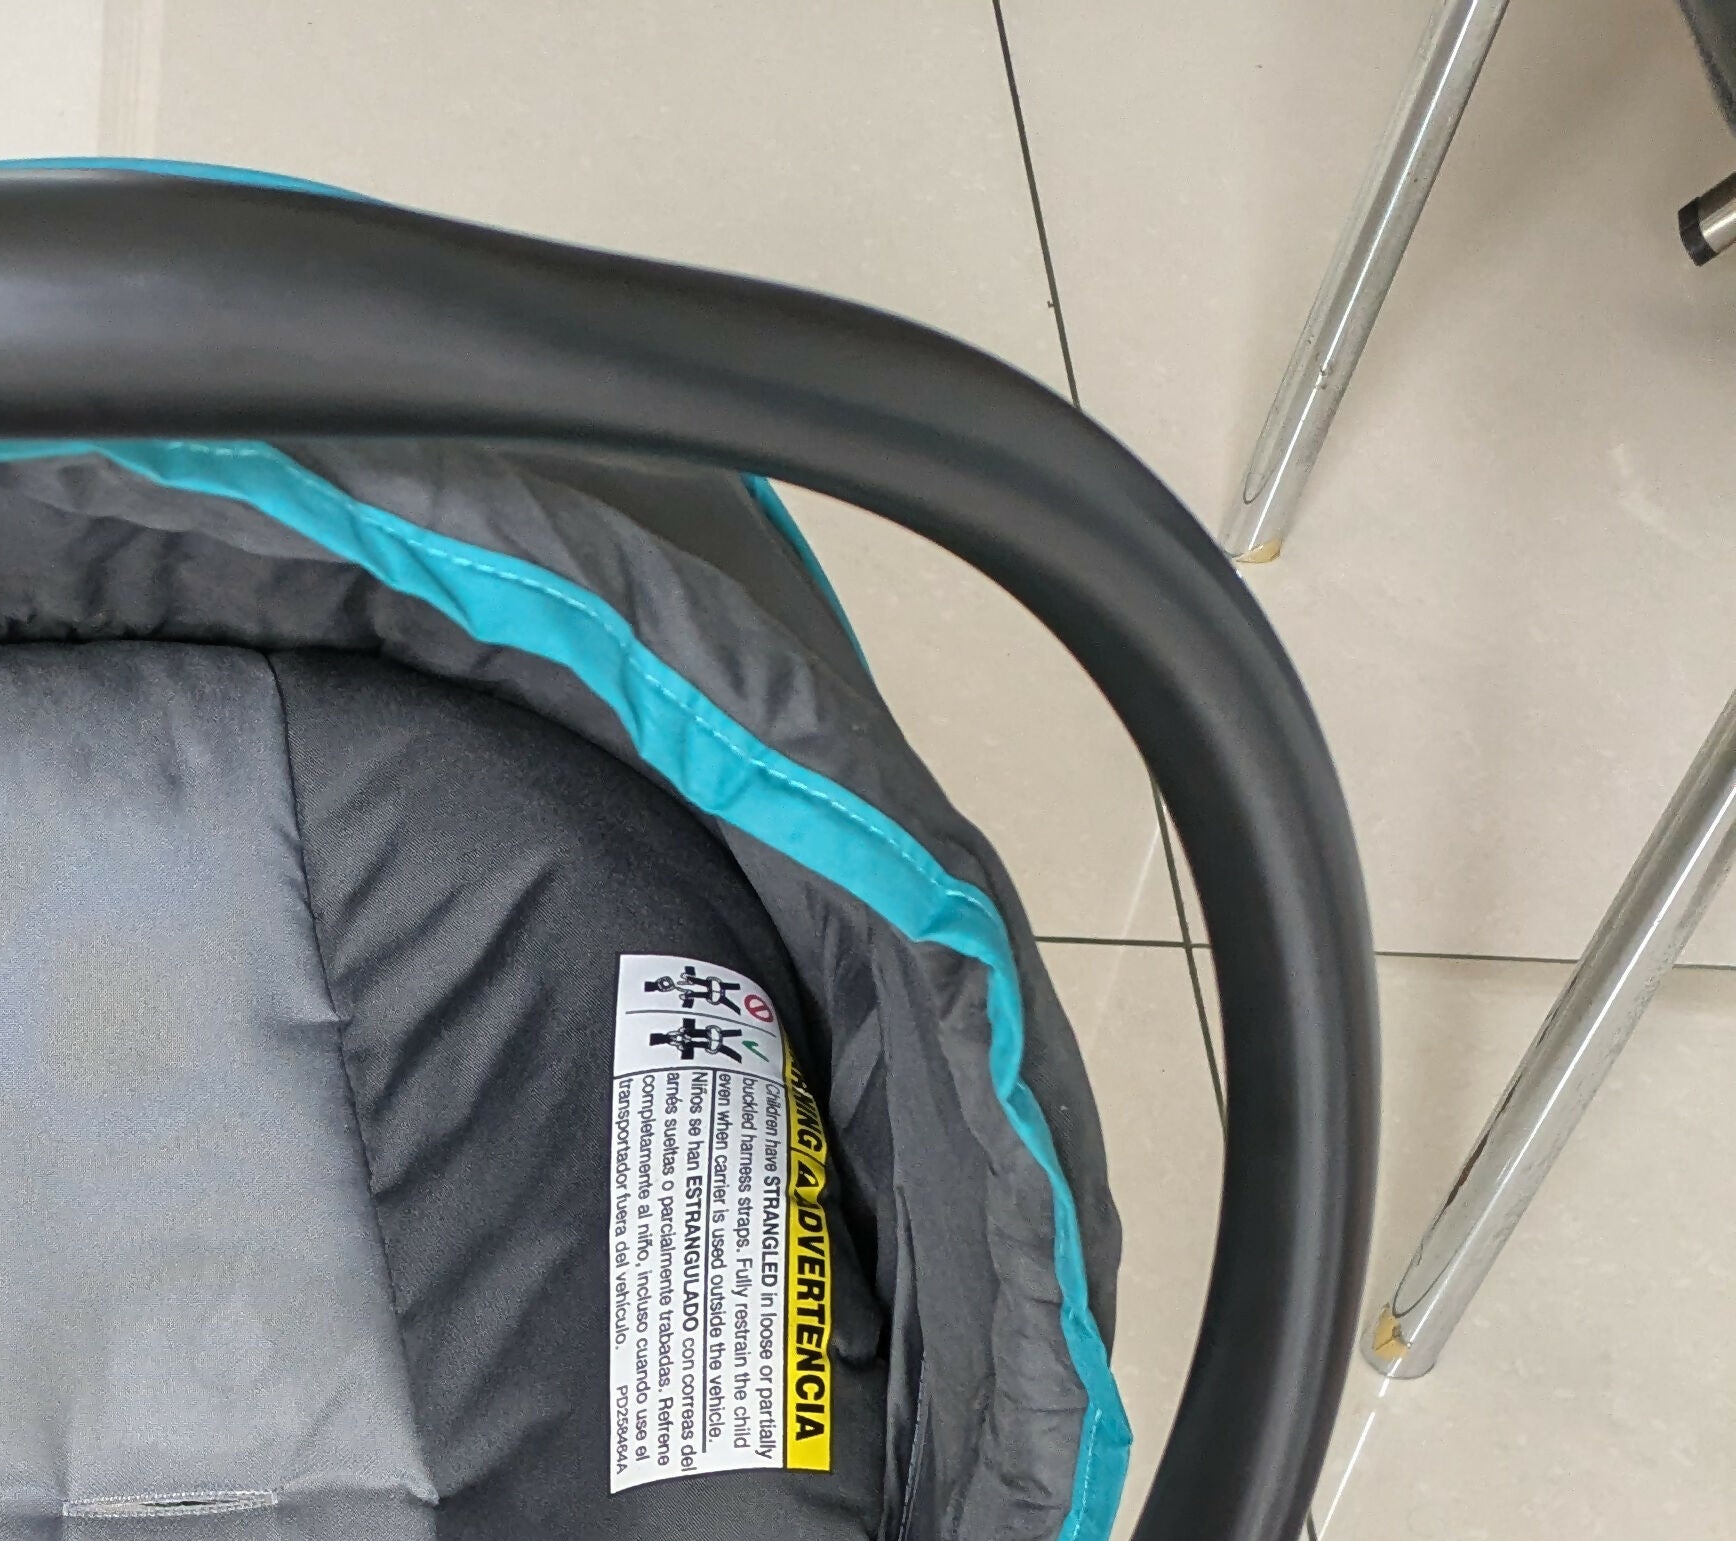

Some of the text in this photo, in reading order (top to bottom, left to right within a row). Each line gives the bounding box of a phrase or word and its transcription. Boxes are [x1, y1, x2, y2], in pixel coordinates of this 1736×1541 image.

[615, 1079, 633, 1350] transportador fuera del vehículo.
[635, 1075, 656, 1461] completamente al niño, incluso cuando use el
[657, 1073, 683, 1466] arnés sueltas o parcialmente trabadas. Refrene
[681, 1072, 708, 1471] Niños se han ESTRANGULADO con correas del
[709, 1073, 733, 1443] even when carrier is used outside the vehicle.
[731, 1078, 757, 1448] buckled harness straps. Fully restrain the child
[755, 1084, 781, 1459] Children have STRANGLED in loose or partially
[791, 1059, 823, 1152] RNING
[616, 1385, 628, 1474] PD258464A
